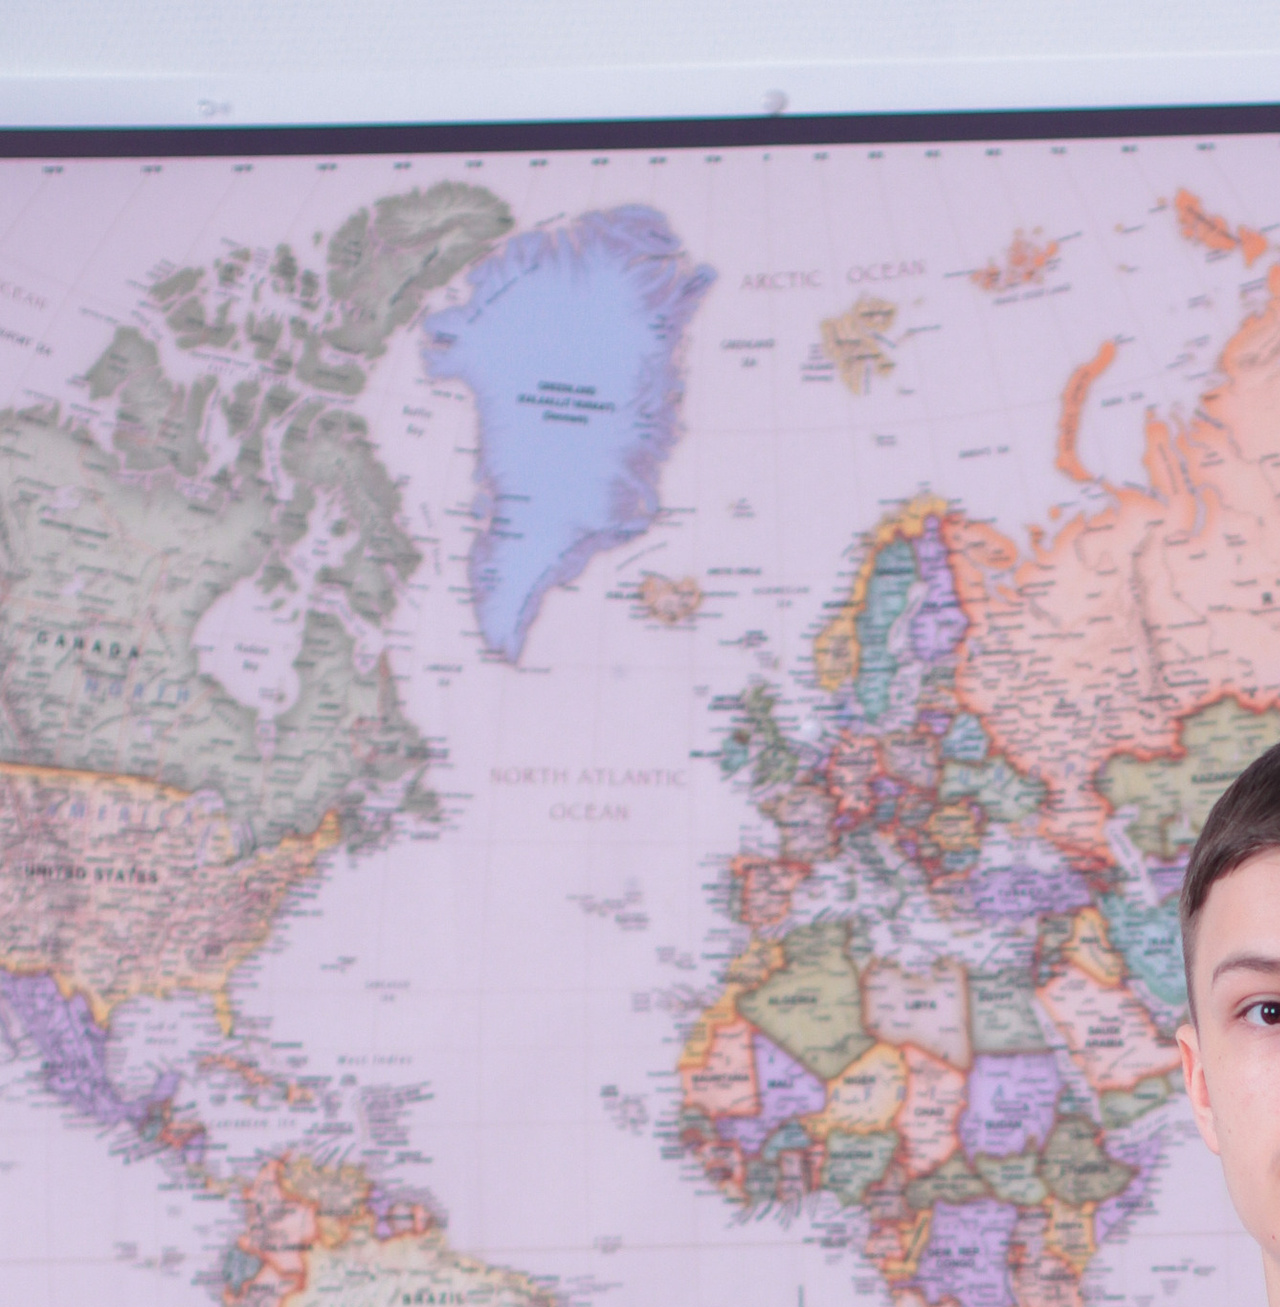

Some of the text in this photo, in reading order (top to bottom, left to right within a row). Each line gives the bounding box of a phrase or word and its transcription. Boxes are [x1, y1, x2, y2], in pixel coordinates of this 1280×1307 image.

[740, 260, 926, 291] ARCTIC OCEAN
[36, 630, 139, 661] CANADA
[489, 765, 688, 789] NORTH ATLANTIC
[549, 802, 629, 823] OCEAN
[402, 1293, 466, 1306] BRAZIL
